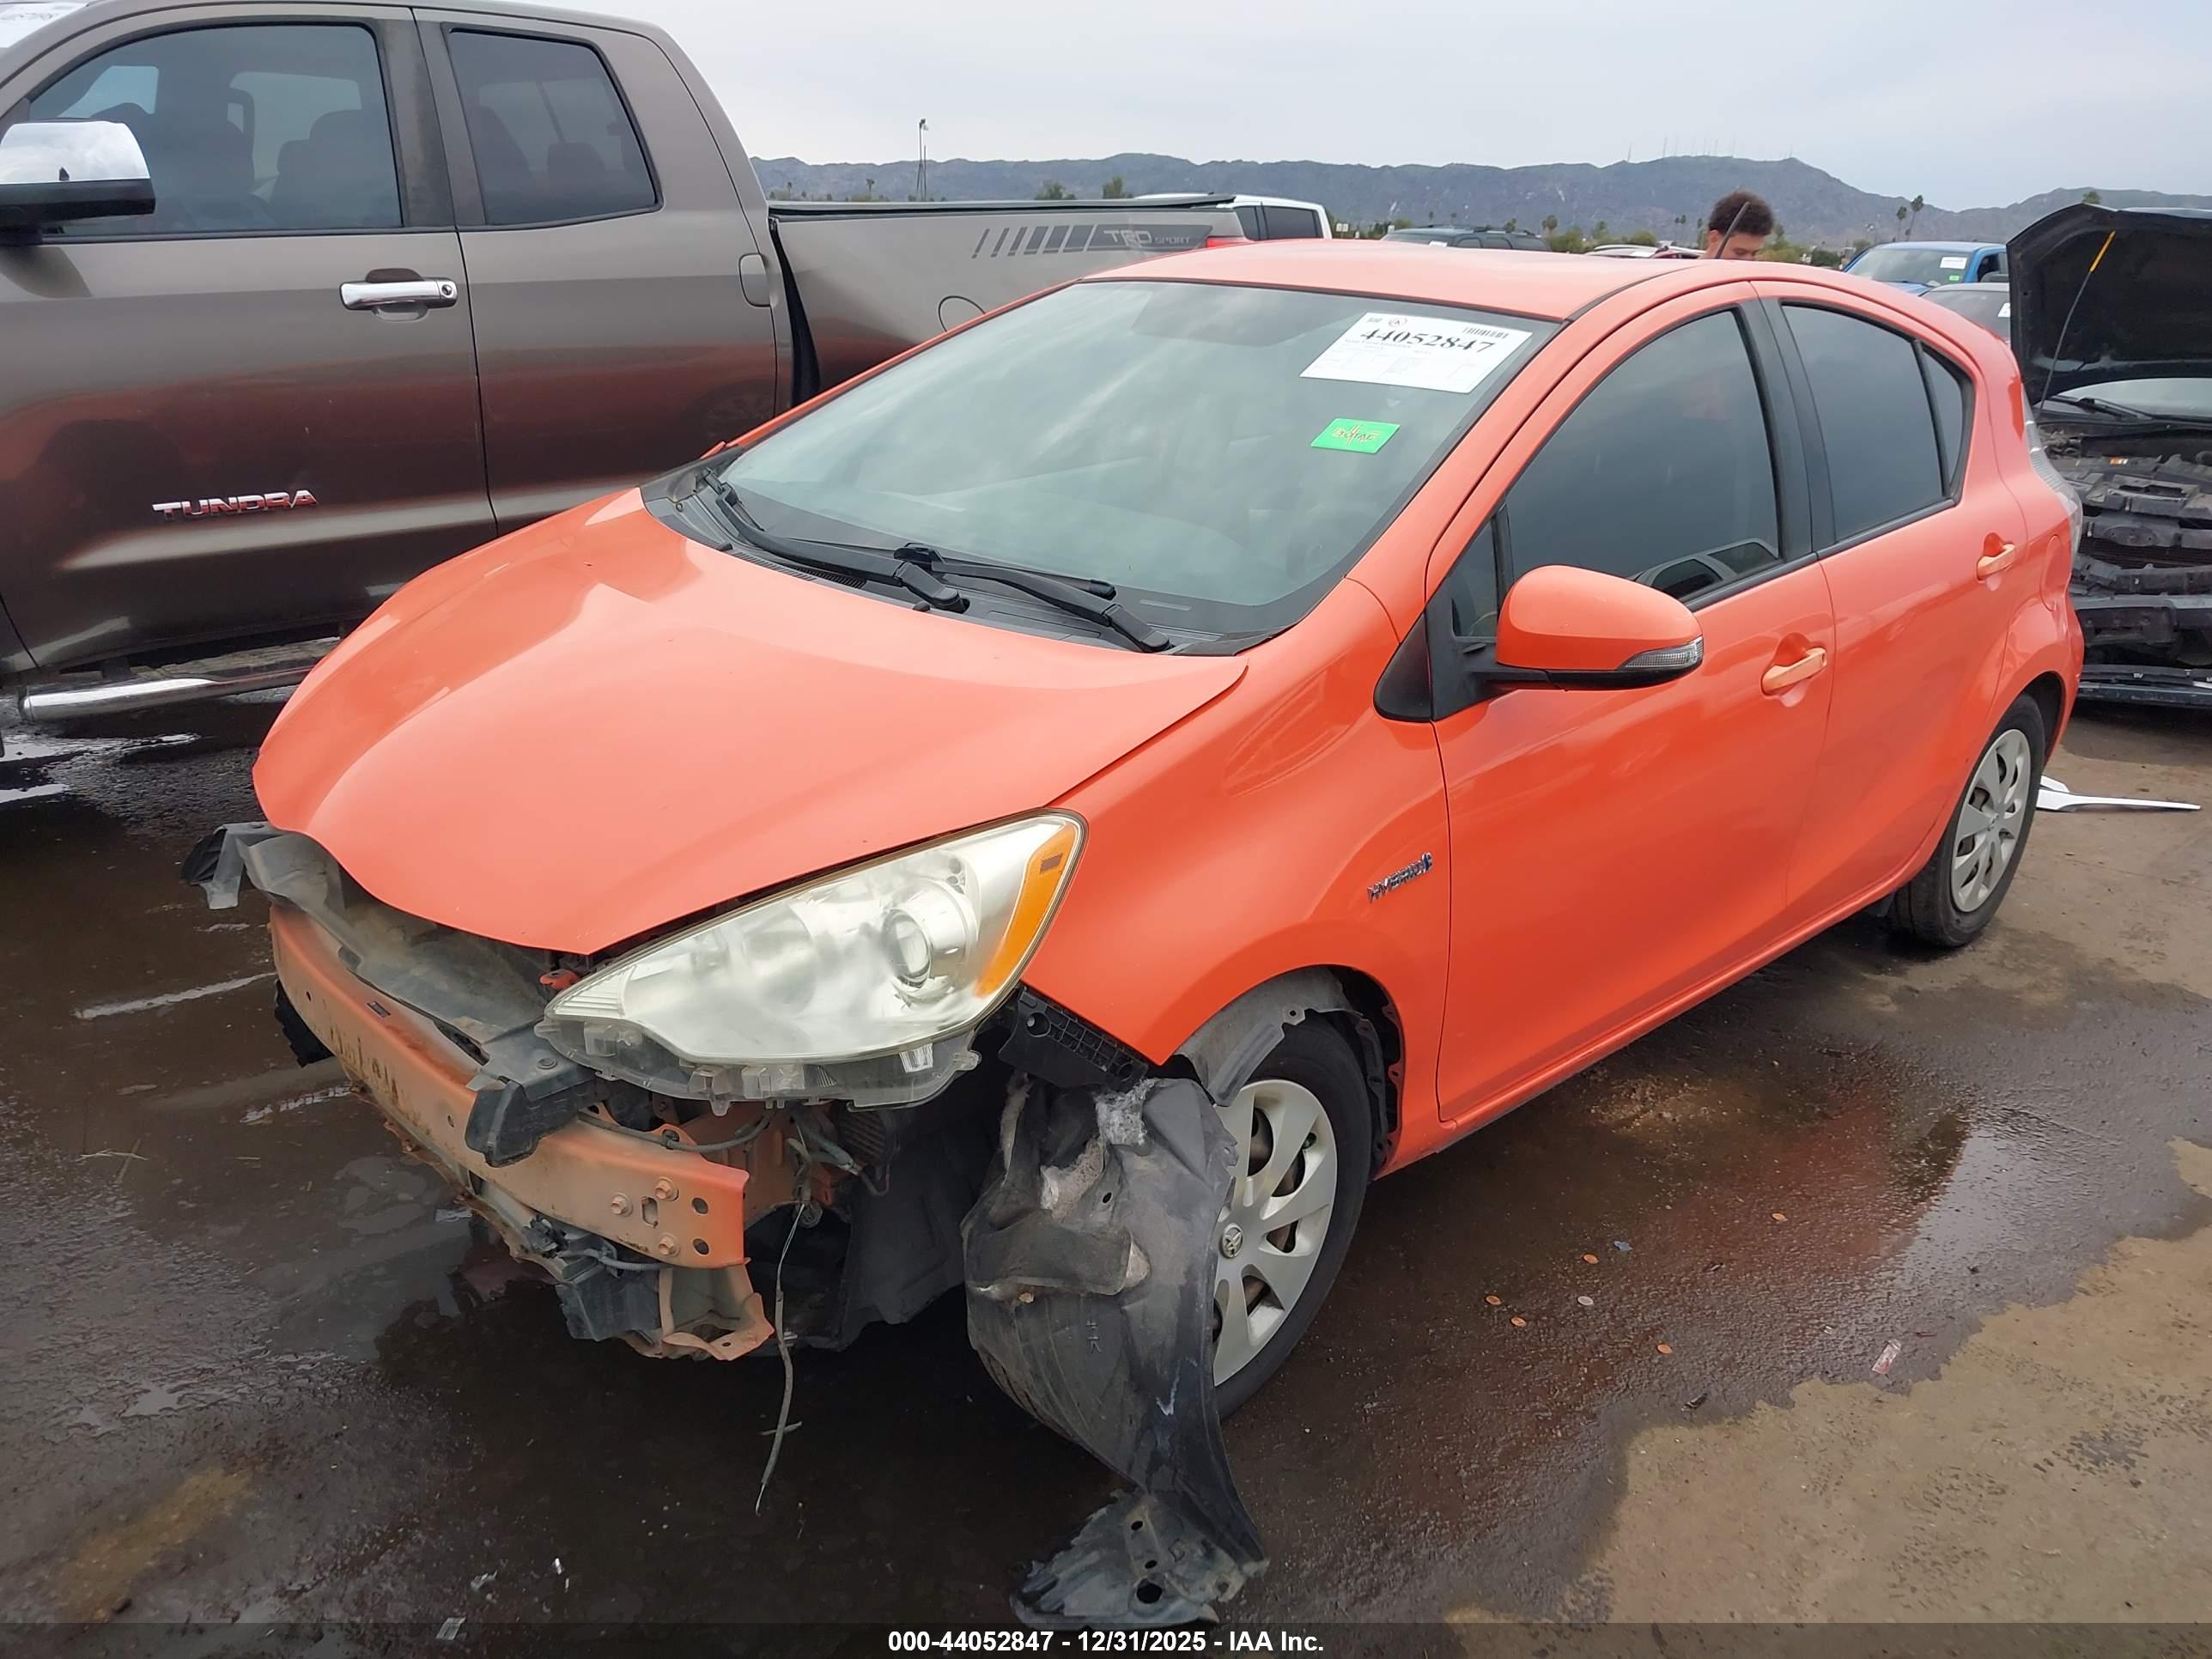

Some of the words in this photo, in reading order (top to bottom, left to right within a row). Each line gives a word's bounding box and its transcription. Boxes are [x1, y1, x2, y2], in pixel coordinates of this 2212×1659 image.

[1103, 229, 1153, 248] TRD
[1360, 328, 1497, 353] 44052847
[152, 489, 318, 520] TUNDRA
[1367, 860, 1426, 903] HYBRID
